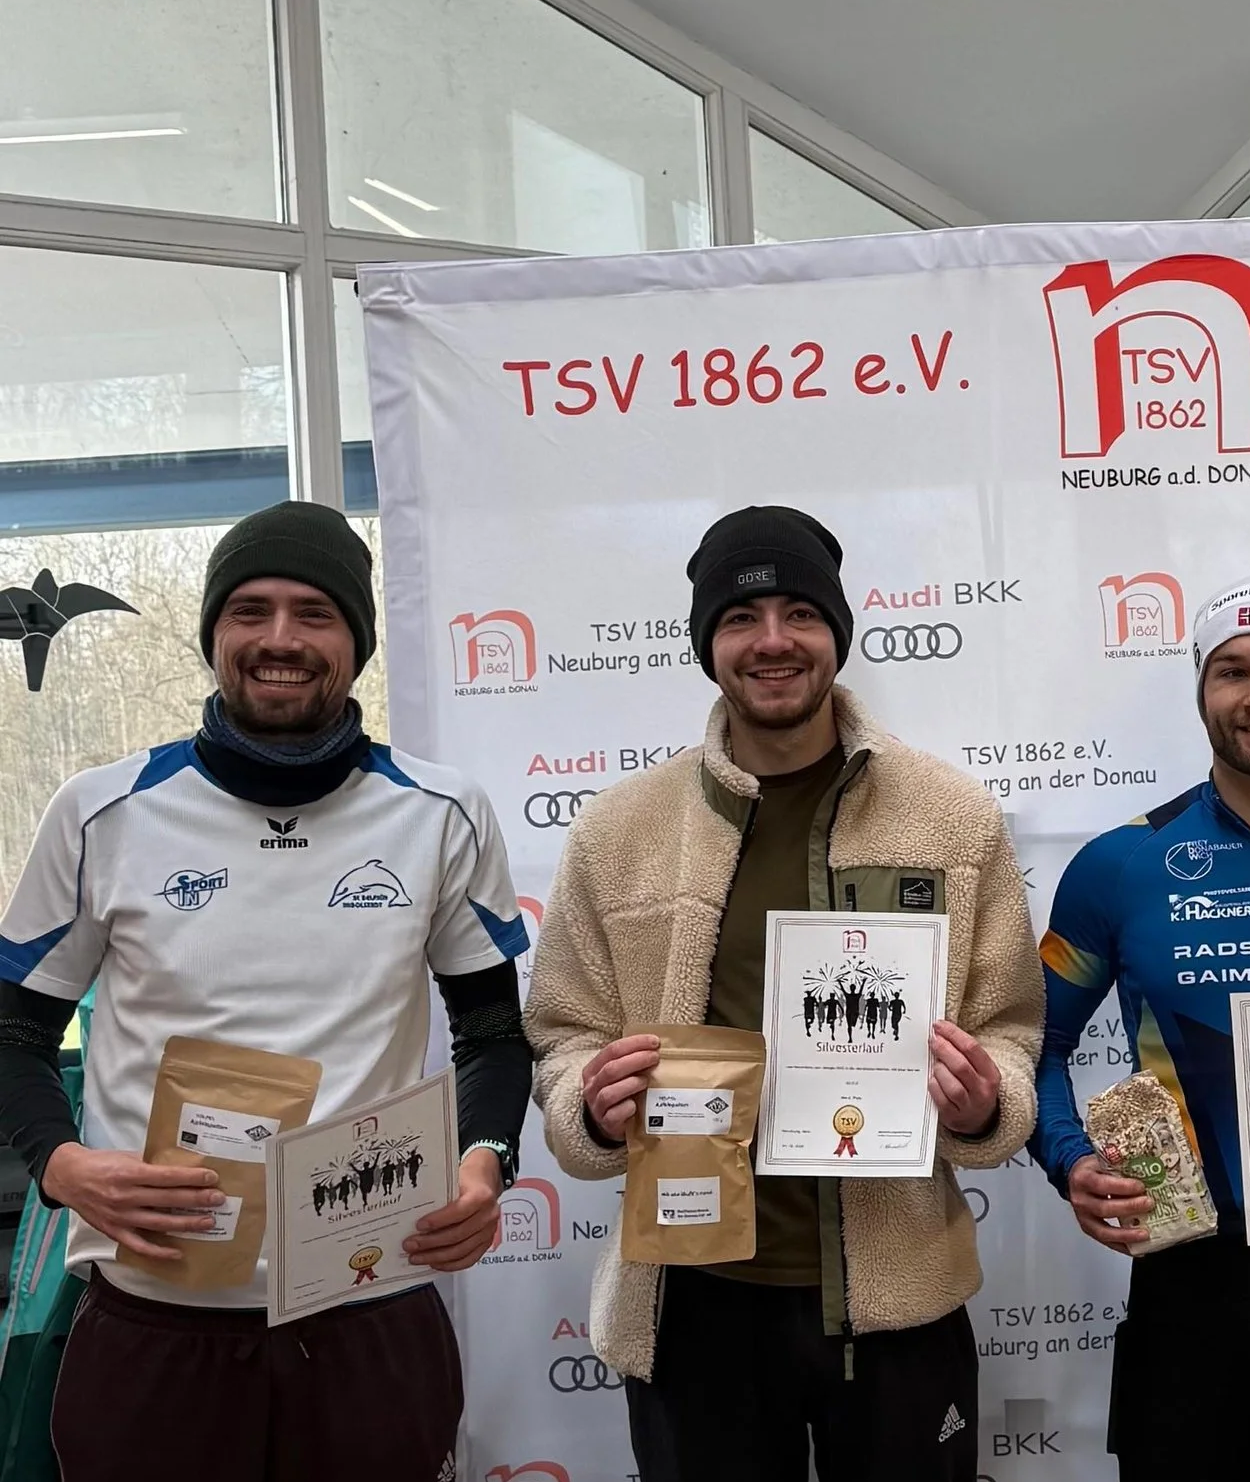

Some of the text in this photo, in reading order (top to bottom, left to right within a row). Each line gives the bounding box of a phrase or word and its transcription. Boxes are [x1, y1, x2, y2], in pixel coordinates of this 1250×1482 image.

[503, 329, 971, 417] TSV 1862 e.V.
[1121, 346, 1212, 385] TSV
[1136, 398, 1207, 430] 1862
[1061, 467, 1162, 490] NEUBURG
[1167, 465, 1201, 486] a.d.
[737, 570, 770, 585] GORE
[862, 579, 1023, 611] Audi BKK
[1127, 606, 1160, 620] TSV
[590, 621, 636, 642] TSV
[1131, 624, 1159, 638] 1862
[476, 643, 511, 658] TSV
[1157, 647, 1188, 658] DONAU
[482, 662, 509, 675] 1862
[548, 651, 640, 674] Neuburg
[647, 651, 672, 667] an
[961, 738, 1112, 766] TSV 1862 e.V.
[526, 750, 607, 776] Audi
[1018, 772, 1043, 791] an
[1049, 768, 1085, 790] der
[1093, 767, 1157, 788] Donau
[259, 835, 309, 850] erima
[1087, 1018, 1126, 1038] e.V.
[816, 1040, 886, 1054] Silvesterlauf
[840, 1116, 858, 1126] TSV
[503, 1212, 537, 1225] TSV
[505, 1230, 533, 1242] 1862
[990, 1302, 1095, 1327] TSV 1862
[978, 1330, 1116, 1360] uburg an der
[993, 1431, 1062, 1457] BKK
